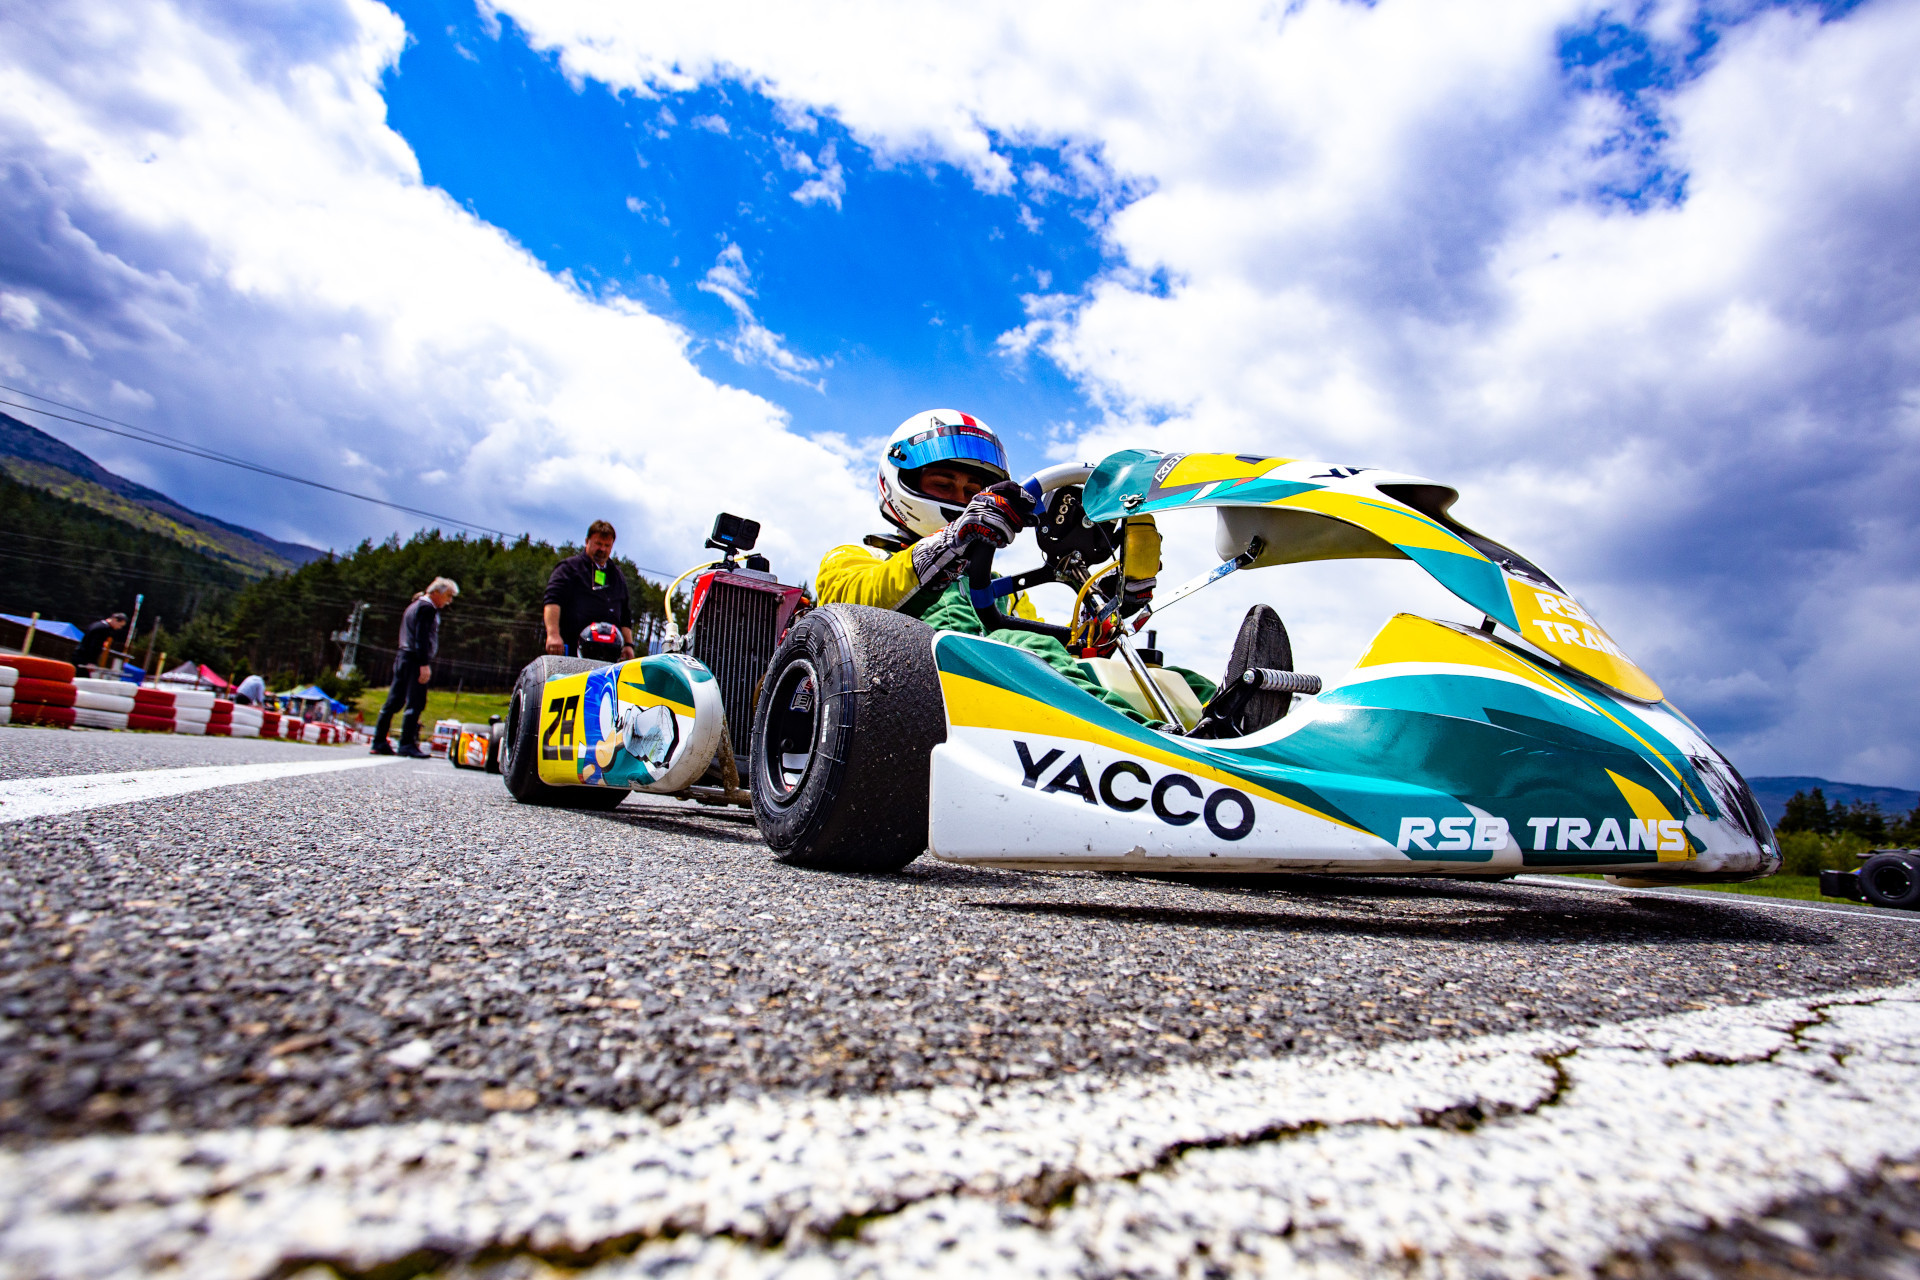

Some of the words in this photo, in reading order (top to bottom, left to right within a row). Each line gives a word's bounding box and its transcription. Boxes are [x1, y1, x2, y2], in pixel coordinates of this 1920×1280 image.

[1013, 739, 1256, 841] YACCO
[1397, 816, 1510, 850] RSB
[1526, 816, 1685, 850] TRANS
